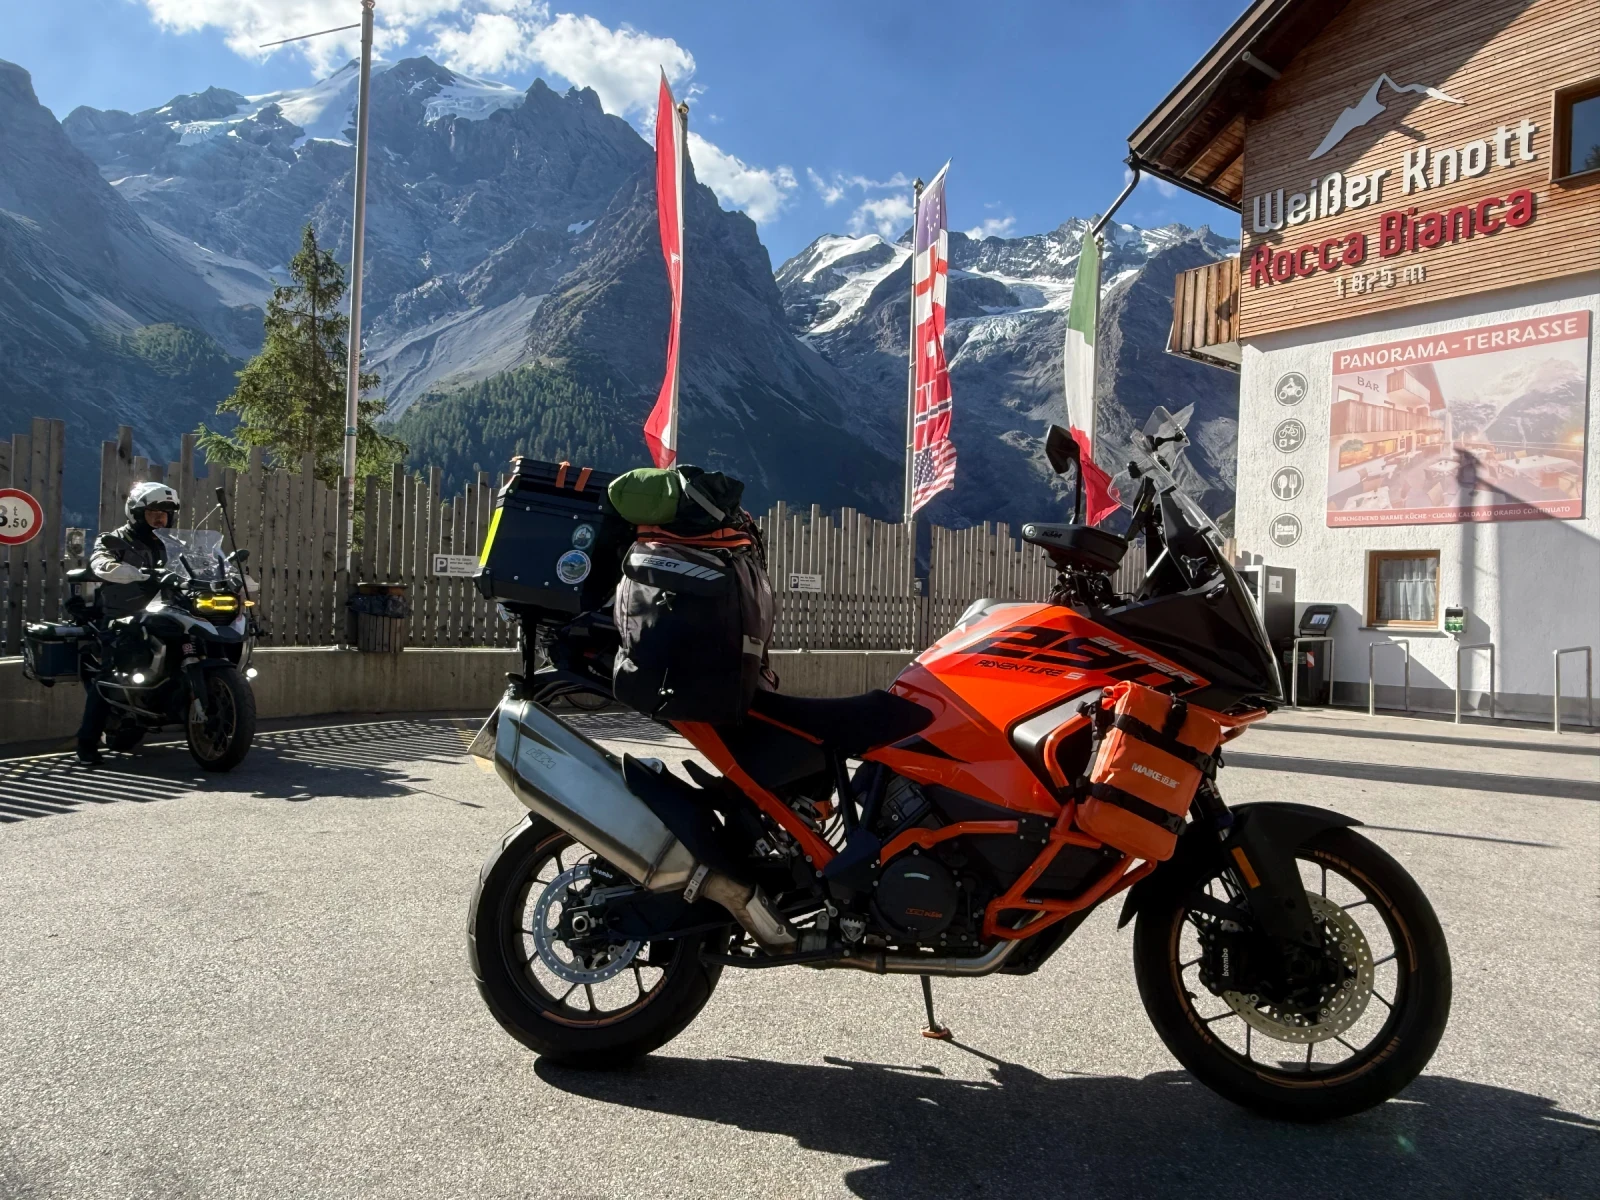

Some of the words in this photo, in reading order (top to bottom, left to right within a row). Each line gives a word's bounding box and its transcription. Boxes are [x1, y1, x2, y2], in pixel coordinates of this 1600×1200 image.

[1252, 169, 1389, 233] Weißer
[1402, 119, 1535, 194] Knott
[1250, 231, 1363, 287] Rocca
[1379, 189, 1532, 257] Bianca
[1403, 264, 1423, 282] m
[1357, 375, 1380, 393] BAR
[1405, 512, 1427, 520] KÜCHE
[1432, 511, 1457, 519] CUCINA
[1494, 508, 1521, 517] ORARIO
[1523, 506, 1571, 515] CONTINUATO
[436, 558, 447, 572] P
[791, 576, 799, 588] P
[975, 660, 1066, 677] ADVENTURE
[1063, 672, 1086, 680] S
[1089, 636, 1198, 684] SUPER
[1131, 762, 1162, 782] MAIKE
[1221, 947, 1229, 976] brembo
